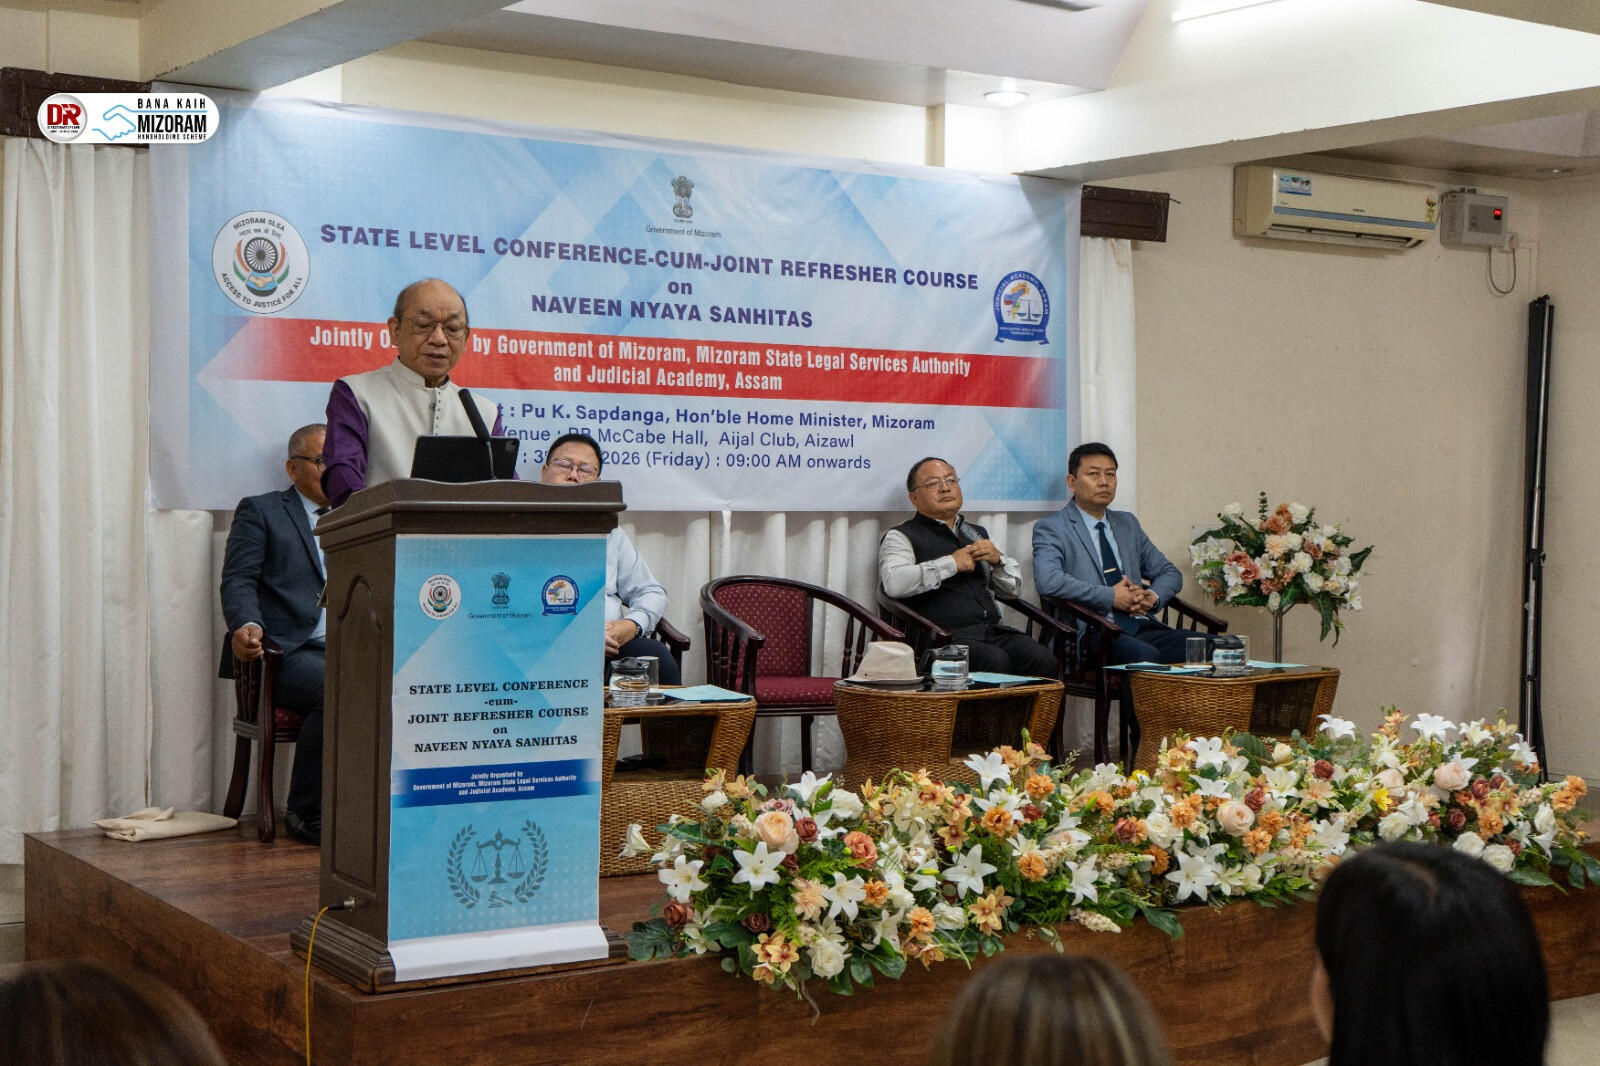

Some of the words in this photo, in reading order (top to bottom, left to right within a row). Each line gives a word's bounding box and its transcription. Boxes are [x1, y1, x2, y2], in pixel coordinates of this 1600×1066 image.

[232, 217, 266, 231] MIZORAM
[645, 224, 685, 236] Government
[694, 229, 722, 238] Mizoram
[320, 223, 400, 248] STATE
[409, 230, 485, 254] LEVEL
[493, 237, 774, 275] CONFERENCE-CUM-JOINT
[780, 259, 897, 284] REFRESHER
[903, 268, 979, 290] COURSE
[221, 273, 242, 299] ACCESS
[242, 296, 252, 305] TO
[252, 298, 282, 308] JUSTICE
[281, 289, 295, 301] FOR
[293, 276, 303, 290] ALL
[667, 281, 693, 295] on
[531, 294, 622, 318] NAVEEN
[630, 300, 702, 322] NYAYA
[709, 305, 813, 328] SANHITAS
[310, 325, 374, 350] Jointly
[472, 333, 491, 356] by
[497, 334, 594, 359] Government
[598, 341, 614, 360] of
[618, 341, 691, 365] Mizoram,
[696, 345, 761, 366] Mizoram
[765, 348, 803, 369] State
[807, 350, 845, 372] Legal
[849, 352, 908, 373] Services
[912, 356, 971, 378] Authority
[553, 364, 582, 383] and
[586, 365, 651, 385] Judicial
[656, 367, 730, 391] Academy,
[734, 371, 783, 391] Assam
[521, 403, 545, 418] Pu
[552, 404, 571, 419] K.
[575, 405, 670, 425] Sapdanga,
[676, 408, 742, 424] Hon'ble
[747, 410, 794, 425] Home
[799, 412, 867, 430] Minister,
[872, 414, 935, 430] Mizoram
[597, 428, 666, 445] McCabe
[672, 430, 709, 447] Hall,
[718, 431, 754, 450] Aijal
[760, 432, 800, 449] Club,
[804, 433, 855, 448] Aizawl
[601, 450, 641, 466] 2026
[646, 451, 710, 470] (Friday)
[726, 453, 771, 468] 09:00
[775, 454, 801, 468] AM
[806, 455, 871, 469] onwards
[409, 683, 452, 695] STATE
[455, 682, 498, 694] LEVEL
[502, 679, 589, 692] CONFERENCE
[484, 698, 518, 706] -cum-
[408, 713, 449, 725] JOINT
[453, 709, 534, 722] REFRESHER
[538, 706, 589, 719] COURSE
[492, 726, 508, 735] on
[414, 741, 468, 753] NAVEEN
[472, 738, 512, 750] NYAYA
[515, 735, 578, 748] SANHITAS
[413, 783, 445, 791] Government
[478, 780, 501, 788] Mizoram
[502, 778, 516, 786] State
[517, 777, 531, 786] Legal
[532, 776, 554, 784] Services
[554, 774, 577, 783] Authority
[471, 772, 489, 780] Jointly
[490, 771, 516, 780] Organised
[517, 770, 524, 779] by
[458, 788, 469, 796] and
[469, 787, 491, 796] Judicial
